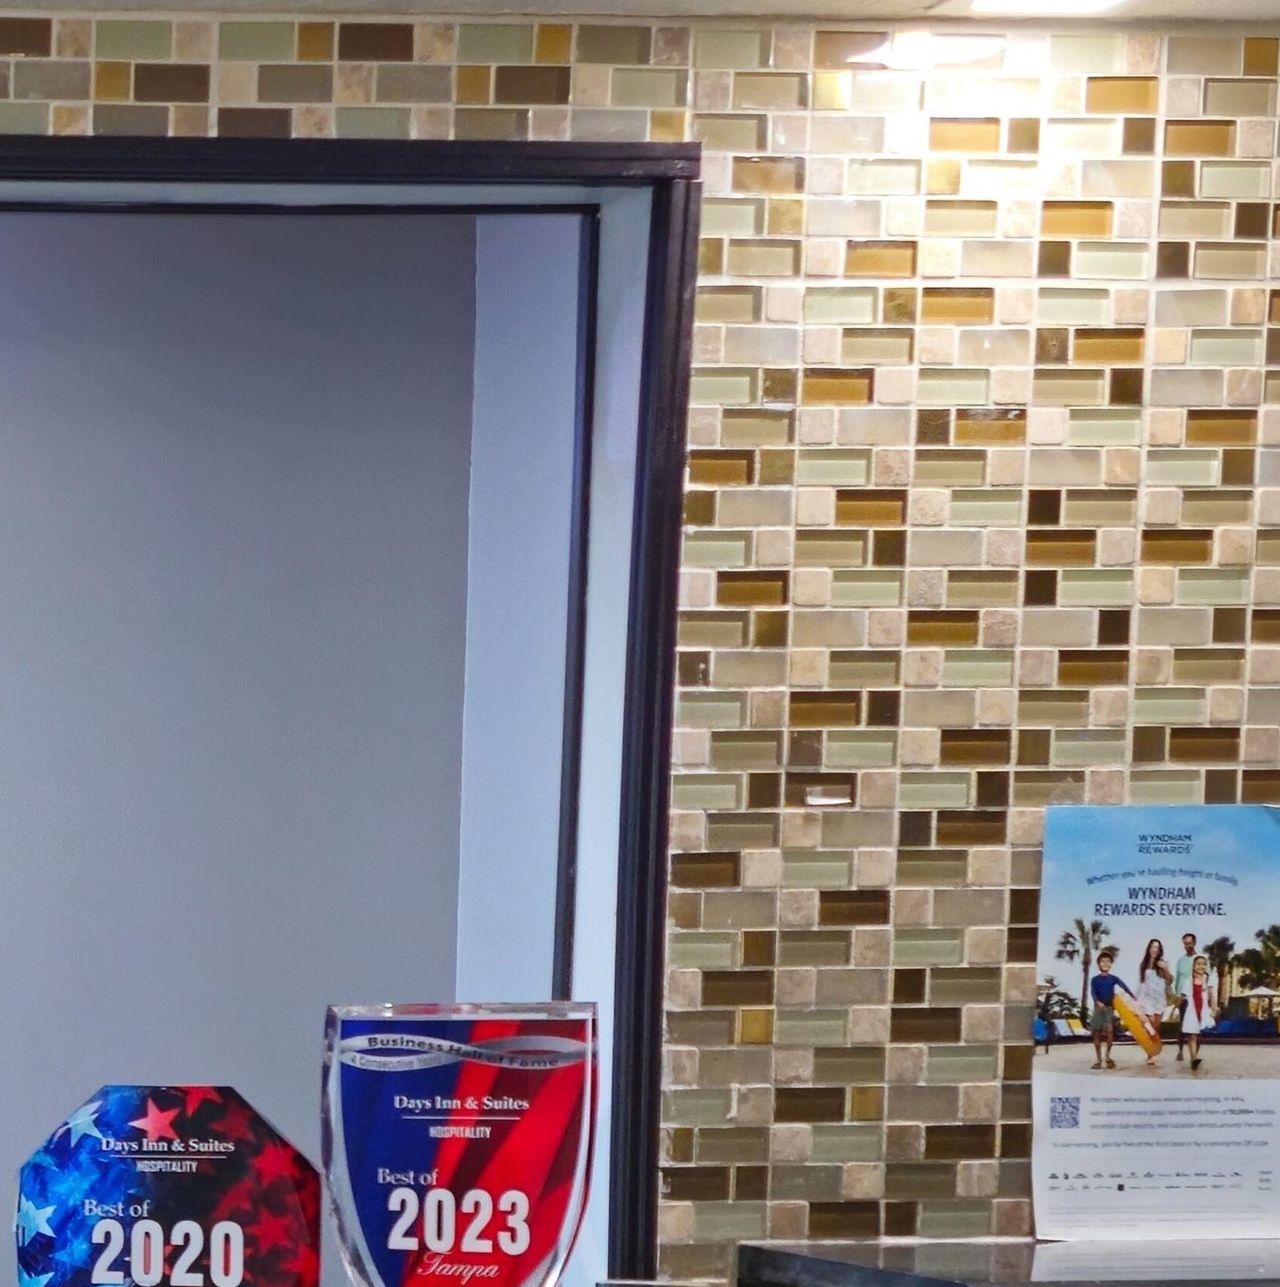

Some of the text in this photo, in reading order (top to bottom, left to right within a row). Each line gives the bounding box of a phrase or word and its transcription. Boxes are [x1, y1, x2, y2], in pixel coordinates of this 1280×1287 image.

[1138, 834, 1192, 842] WYNDHAM
[1138, 845, 1192, 854] REWARDS
[1128, 887, 1196, 900] WYNDHAM
[1094, 903, 1227, 916] REWARDS EVERYONE.
[367, 1037, 444, 1052] Business
[447, 1045, 483, 1059] Hall
[507, 1055, 560, 1068] Fame
[394, 1095, 529, 1113] Days Inn & Suites
[429, 1126, 491, 1139] HOSPITALITY
[101, 1138, 235, 1155] Days Inn & Suites
[136, 1161, 198, 1173] HOSPITALITY
[377, 1168, 439, 1185] Best of
[83, 1199, 151, 1217] Best of
[387, 1187, 530, 1256] 2023
[417, 1252, 500, 1285] Tampa
